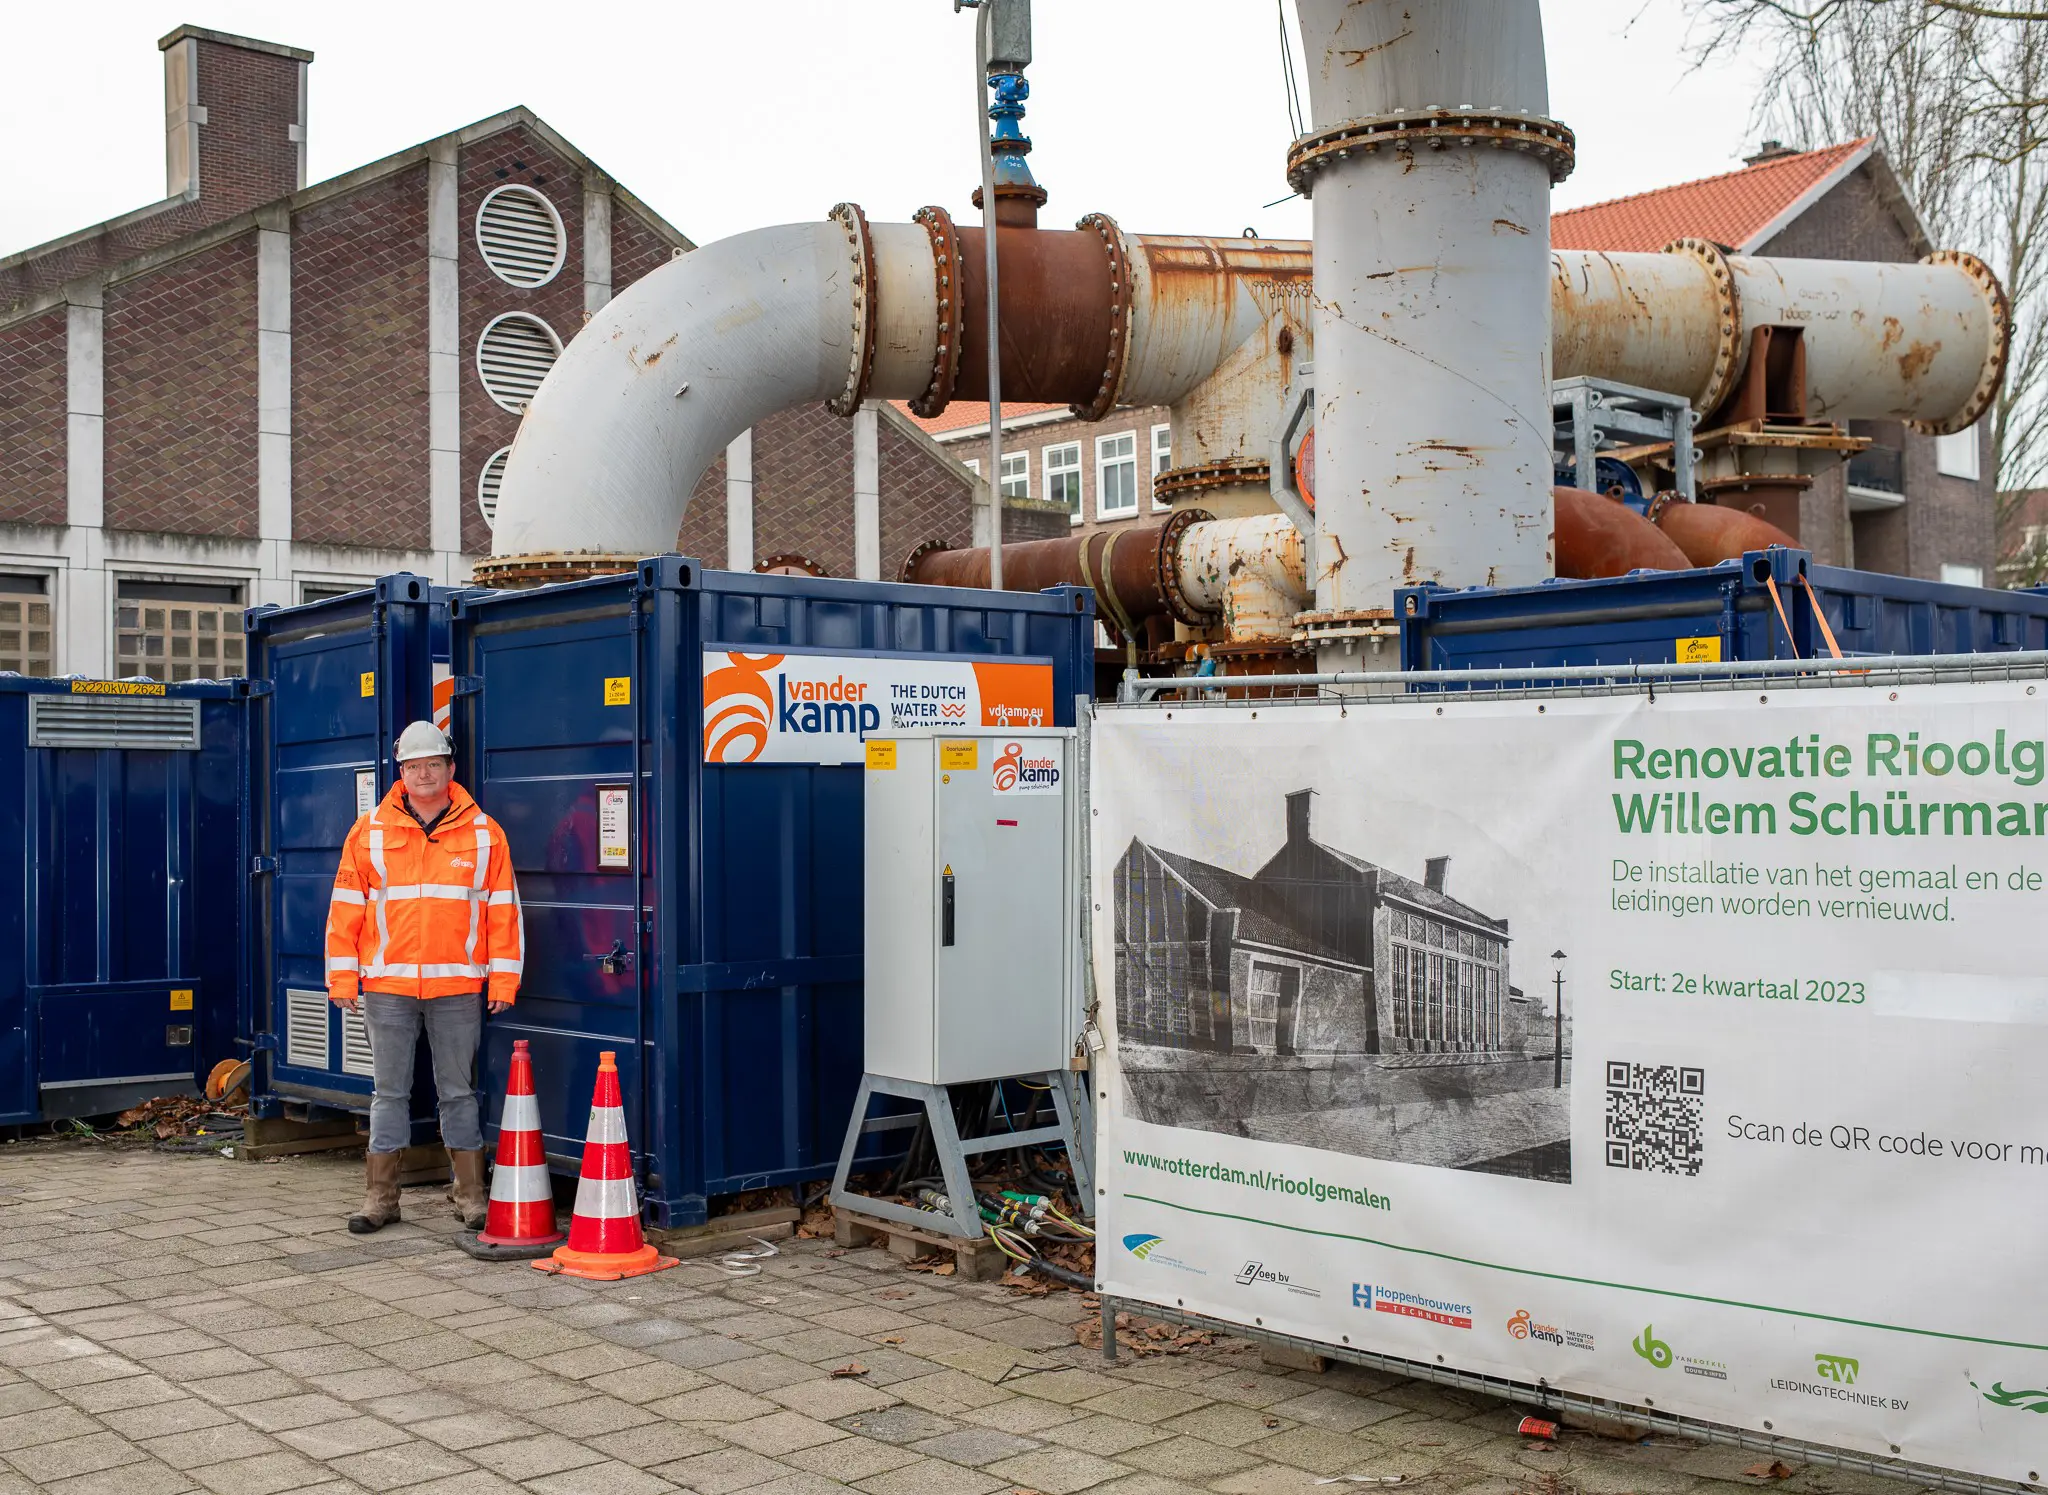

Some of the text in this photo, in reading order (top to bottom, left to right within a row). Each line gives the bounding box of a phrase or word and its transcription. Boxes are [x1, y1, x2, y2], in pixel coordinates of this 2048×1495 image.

[74, 681, 163, 696] 2x220kW 2624
[788, 675, 868, 702] vander
[890, 684, 966, 700] THE DUTCH
[779, 673, 880, 743] kamp
[890, 702, 938, 717] WATER
[988, 703, 1044, 720] vdkamp.eu
[1019, 756, 1060, 786] kamp
[1022, 757, 1055, 769] vander
[1612, 728, 2045, 787] Renovatie Rioolg
[1611, 791, 1777, 834] Willem
[1612, 859, 2042, 893] De installatie van het gemaal en de
[1611, 888, 1955, 922] leidingen worden vernieuwd.
[1609, 969, 1866, 1004] Start: 2e kwartaal 2023
[1727, 1115, 2048, 1165] Scan de QR code voor m
[1123, 1150, 1391, 1211] www.rotterdam.nl/rioolgemalen
[1278, 1271, 1290, 1282] bv
[1375, 1285, 1472, 1315] Hoppenbrouwers
[1392, 1305, 1454, 1325] TECHNIEK
[1529, 1320, 1564, 1346] kamp
[1533, 1323, 1559, 1334] vander
[1770, 1378, 1909, 1411] LEIDINGTECHNIEK BV
